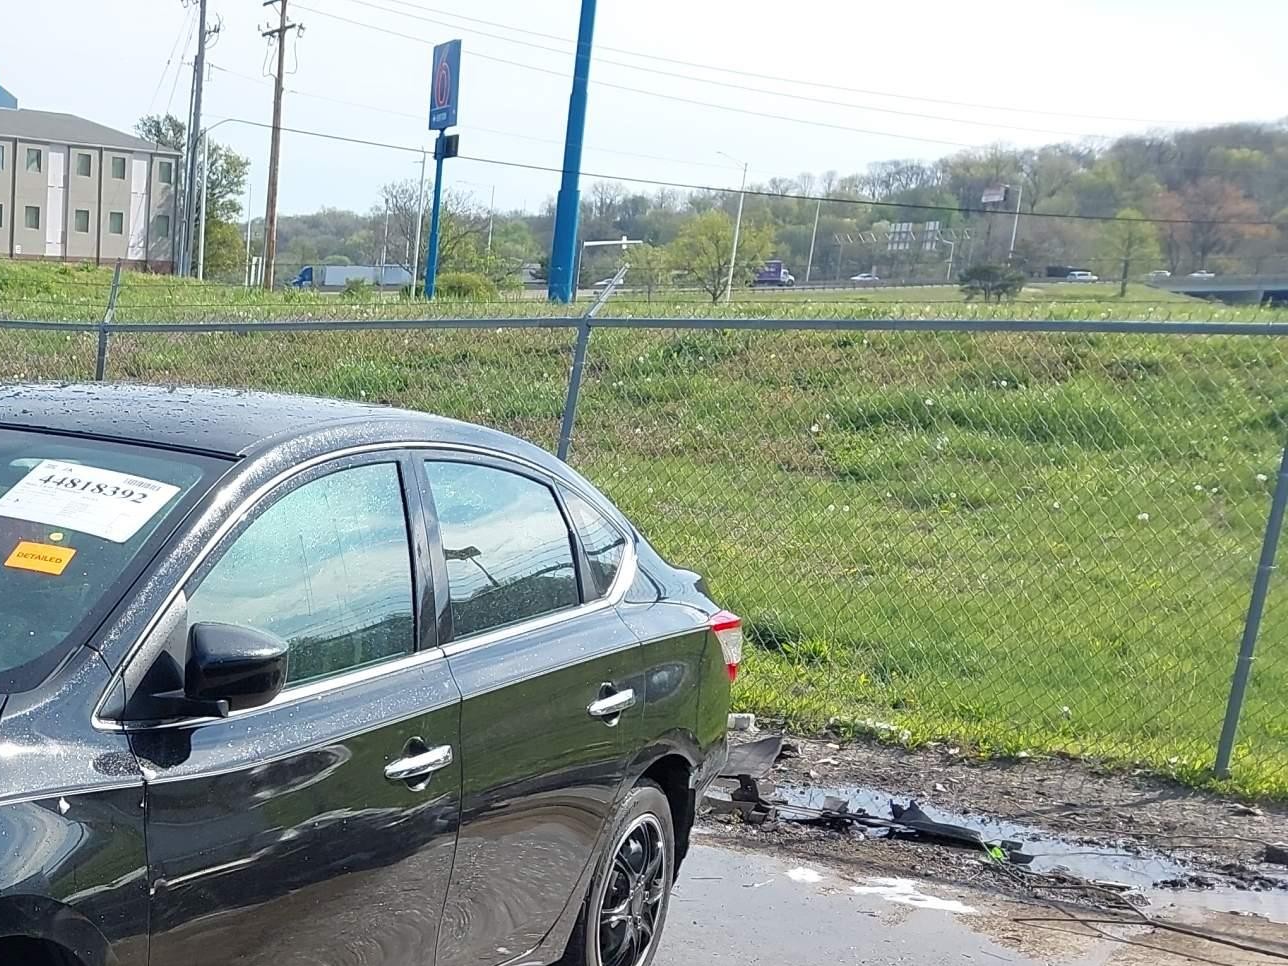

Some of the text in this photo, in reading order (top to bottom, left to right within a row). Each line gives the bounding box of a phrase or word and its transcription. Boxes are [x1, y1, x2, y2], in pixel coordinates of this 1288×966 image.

[434, 44, 451, 108] 6
[39, 475, 148, 504] 44818392
[16, 551, 63, 564] DETAILED
